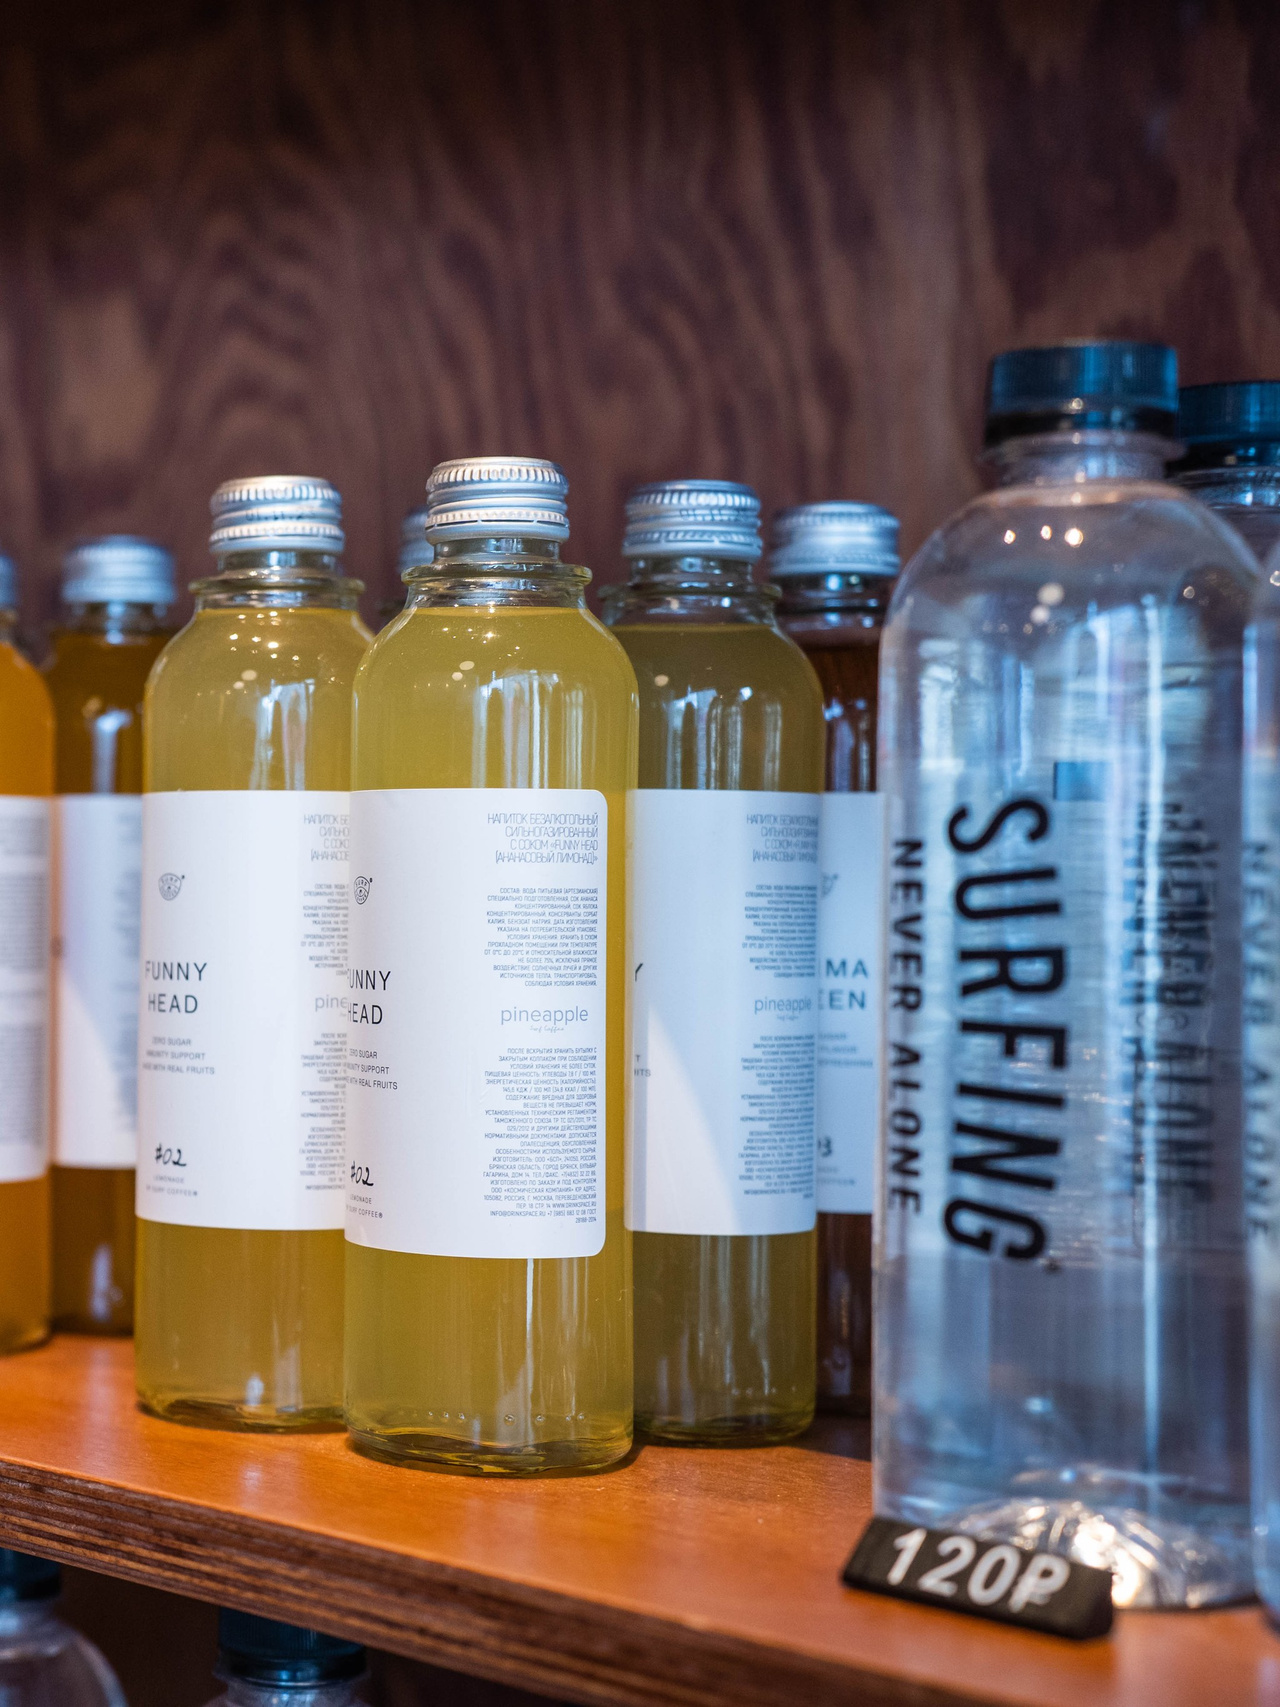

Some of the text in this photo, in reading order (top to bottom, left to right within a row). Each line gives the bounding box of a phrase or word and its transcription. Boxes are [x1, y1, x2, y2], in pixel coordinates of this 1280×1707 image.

[487, 813, 598, 825] НАПИТОК БЕЗАЛКОГОЛЬНЫЙ
[505, 825, 598, 837] СИЛЬНОГАЗИРОВАННЫЙ
[330, 838, 350, 849] СОКО
[518, 839, 548, 850] СОКОМ
[581, 839, 598, 850] HEAD
[145, 960, 207, 981] FUNNY
[825, 958, 869, 978] MA
[148, 993, 198, 1014] HEAD
[754, 996, 812, 1014] pineapple
[348, 1002, 383, 1025] HEAD
[501, 1006, 588, 1025] pineapple
[888, 840, 925, 1214] NEVER ALONE
[942, 797, 1067, 1262] SURFING
[167, 1037, 192, 1046] SUGAR
[170, 1052, 206, 1060] SUPPORT
[359, 1050, 378, 1059] SUGAR
[167, 1064, 184, 1074] REAL
[186, 1066, 215, 1074] FRUITS
[361, 1064, 390, 1075] SUPPORT
[358, 1078, 371, 1088] REAL
[373, 1079, 398, 1090] FRUITS
[155, 1142, 187, 1166] #02
[350, 1160, 374, 1186] #02
[350, 1194, 372, 1204] LEMONADE
